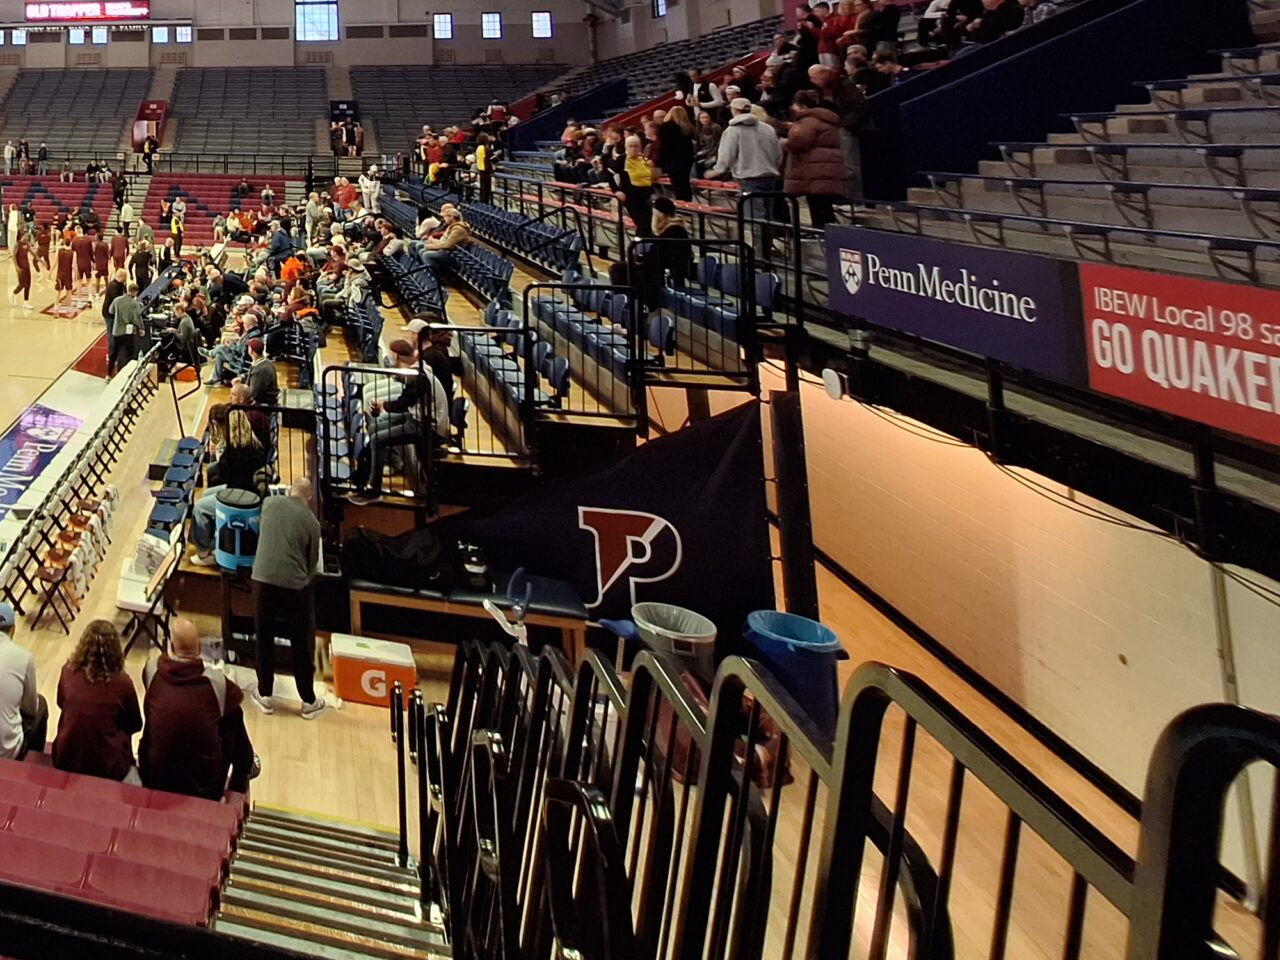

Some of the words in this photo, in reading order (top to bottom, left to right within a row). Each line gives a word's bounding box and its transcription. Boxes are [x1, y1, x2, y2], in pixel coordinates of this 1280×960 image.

[1093, 286, 1147, 319] IBEW
[1152, 297, 1215, 332] Local
[1220, 310, 1253, 340] 98
[1091, 318, 1134, 375] GO
[361, 669, 386, 698] G
